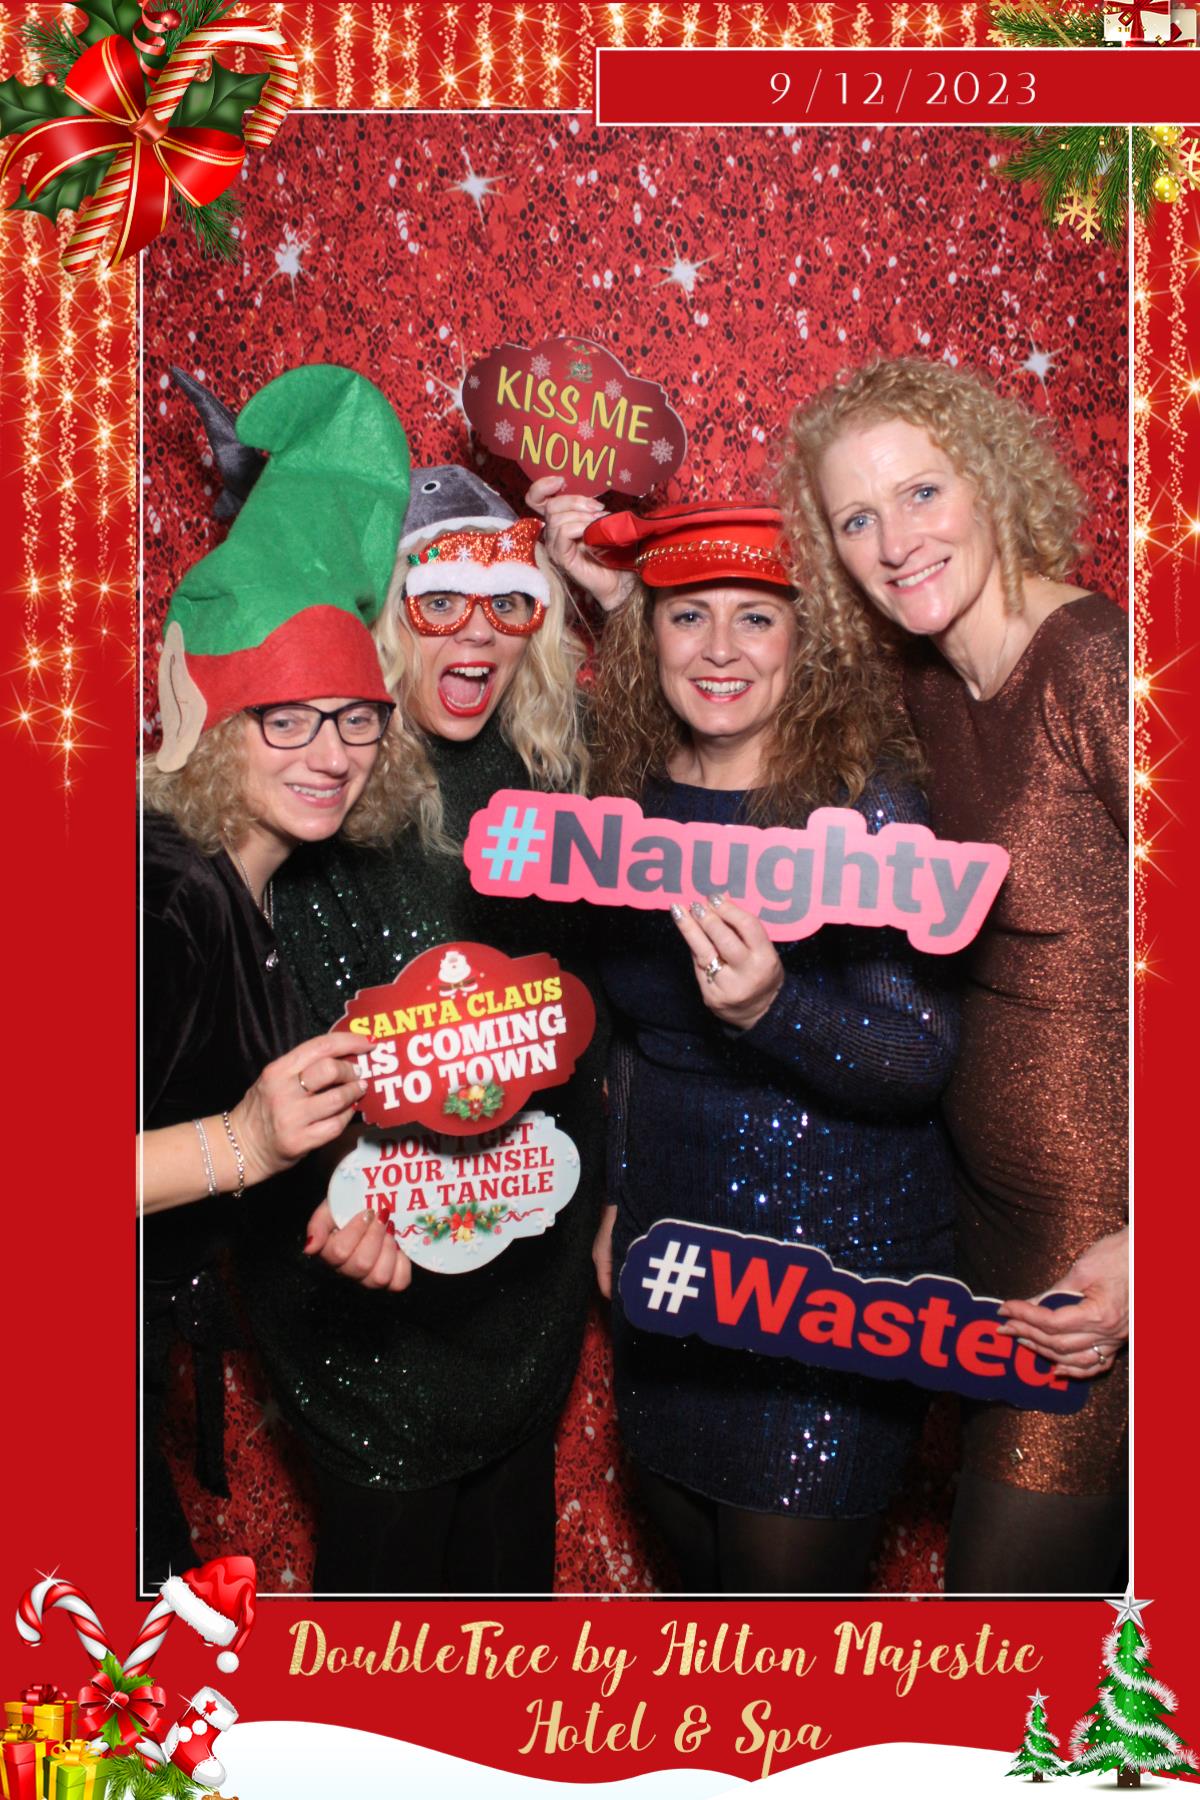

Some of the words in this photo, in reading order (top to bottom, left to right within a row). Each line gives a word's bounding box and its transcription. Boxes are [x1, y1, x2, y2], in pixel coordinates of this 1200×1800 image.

[496, 365, 581, 425] KISS
[590, 390, 653, 444] ME
[520, 424, 616, 487] NOW!
[481, 805, 989, 938] #Naughty
[349, 998, 462, 1038] SANTA
[466, 976, 563, 1018] CLAUS
[356, 1040, 399, 1079] IS
[406, 1004, 567, 1066] COMING
[374, 1070, 432, 1110] TO
[438, 1039, 557, 1094] TOWN
[478, 1122, 533, 1148] GET
[362, 1163, 444, 1189] YOUR
[452, 1146, 554, 1178] TINSEL
[364, 1190, 398, 1214] IN
[406, 1188, 429, 1211] A
[437, 1171, 554, 1207] TANGLE
